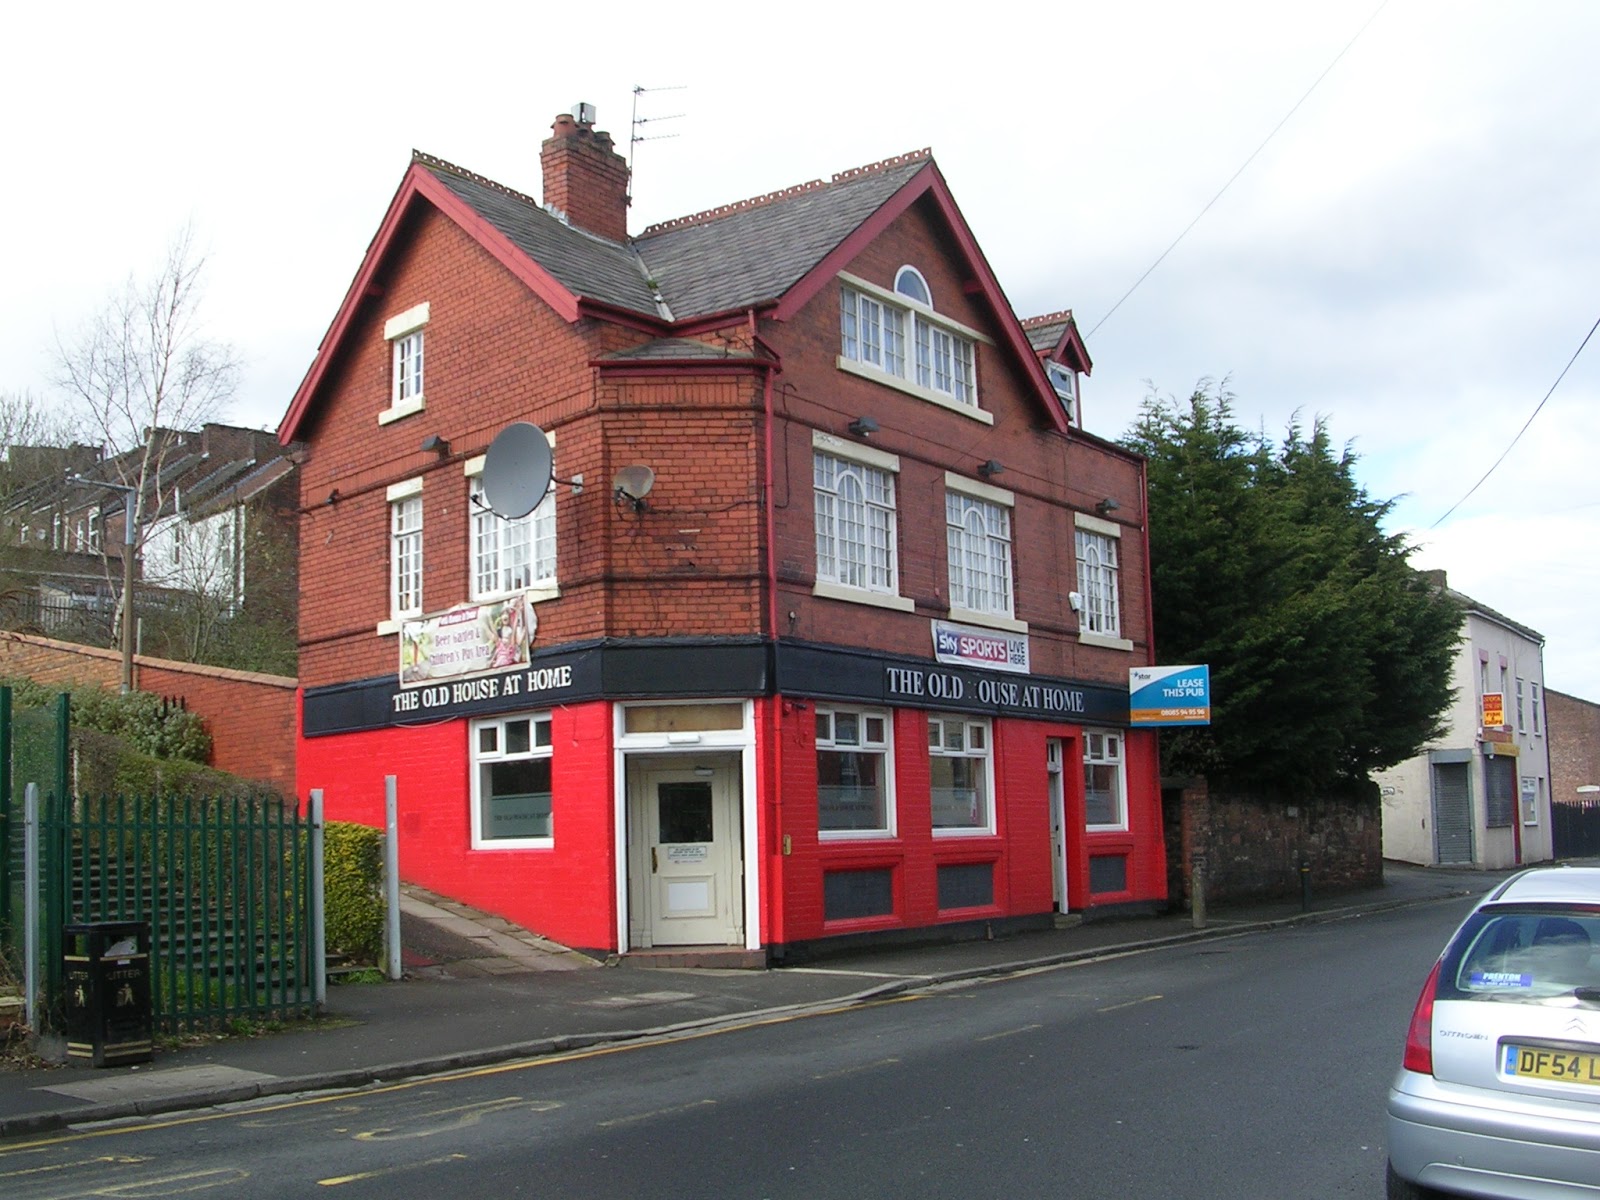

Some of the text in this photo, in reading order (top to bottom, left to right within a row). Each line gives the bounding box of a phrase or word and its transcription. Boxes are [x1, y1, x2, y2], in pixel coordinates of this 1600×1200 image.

[435, 634, 451, 647] Beer
[1009, 640, 1025, 654] LIVE
[462, 648, 474, 661] Play
[476, 645, 490, 657] Area
[960, 637, 1006, 660] SPORTS
[1009, 653, 1026, 666] HERE
[393, 665, 572, 712] THE OLD HOUSE AT HOME
[886, 667, 1084, 713] THE OLD OUSE AT HOME
[1177, 678, 1204, 688] LEASE
[1162, 688, 1205, 697] THIS PUB
[1520, 1051, 1581, 1078] DF54
